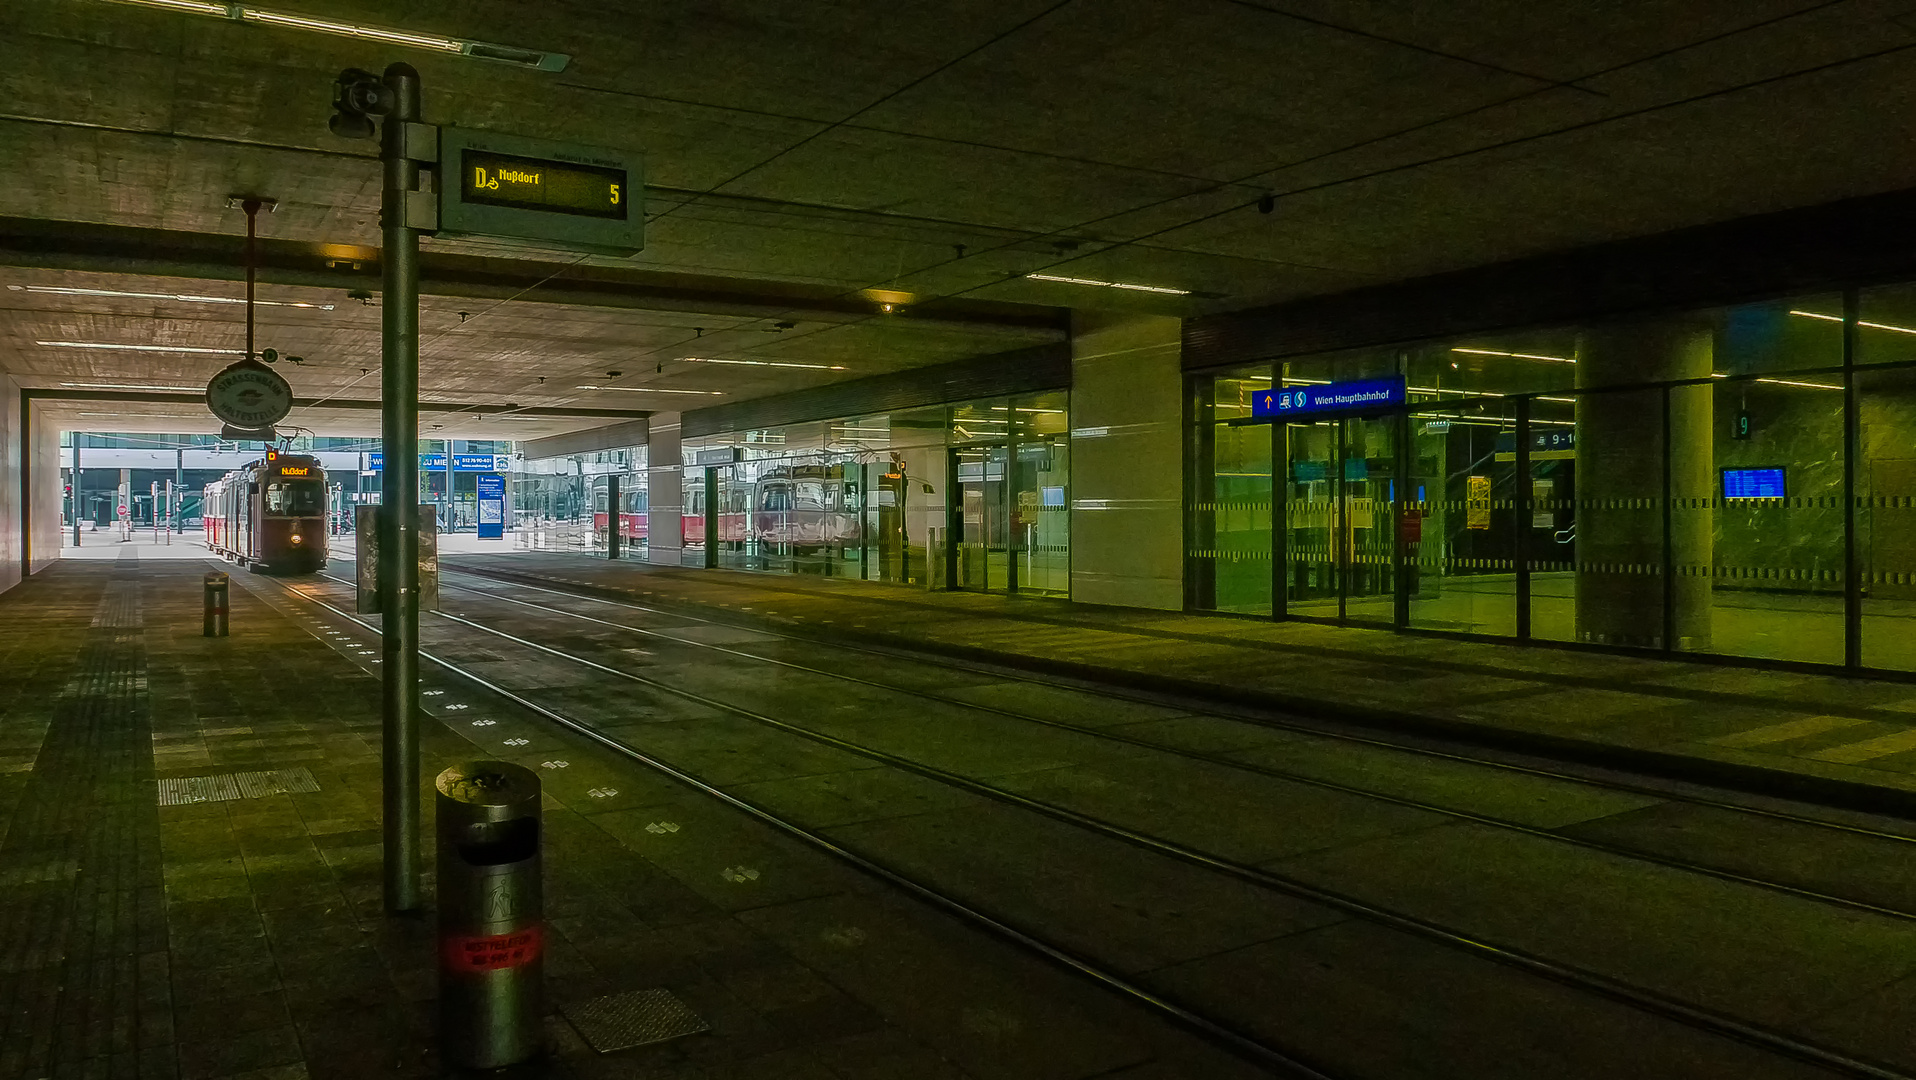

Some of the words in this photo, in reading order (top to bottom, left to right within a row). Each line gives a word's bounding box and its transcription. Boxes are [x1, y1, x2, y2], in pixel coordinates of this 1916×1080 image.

[475, 166, 487, 188] D
[499, 168, 540, 185] Nußdorf
[610, 184, 620, 205] 5
[266, 352, 275, 360] D
[217, 373, 284, 396] STRASSENBAHN
[1314, 395, 1334, 406] Wien
[1335, 390, 1390, 405] Hauptbahnhof
[219, 402, 278, 421] HALTESTELLE
[1740, 415, 1748, 435] 9
[268, 452, 277, 461] D
[433, 458, 460, 467] MIEN
[281, 467, 309, 476] Nußdorf
